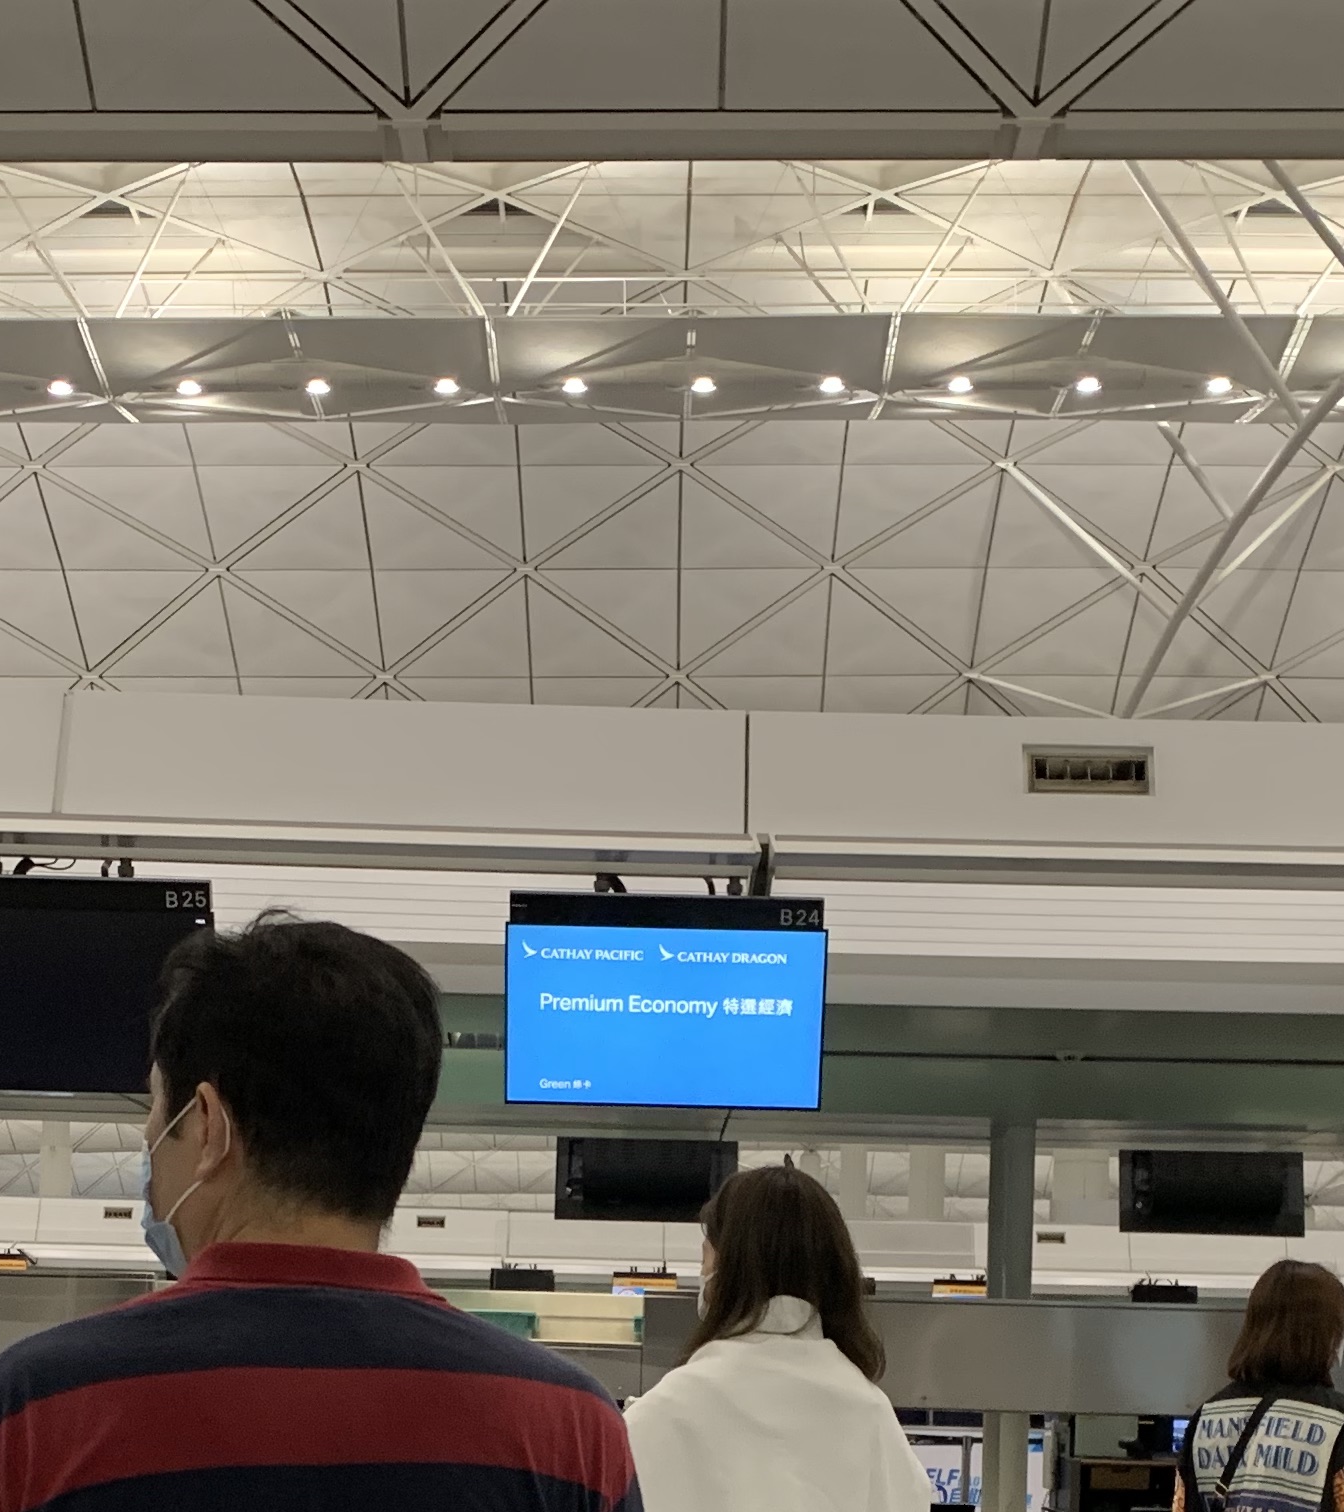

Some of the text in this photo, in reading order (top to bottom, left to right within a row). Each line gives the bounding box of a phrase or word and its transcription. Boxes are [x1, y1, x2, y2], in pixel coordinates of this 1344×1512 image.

[165, 889, 207, 909] B25
[779, 909, 820, 927] B24
[540, 947, 644, 962] CATHAY PACIFIC
[677, 951, 788, 966] CATHAY DRAGON
[539, 993, 794, 1018] Premium Economy 特選經濟
[538, 1077, 571, 1089] Green
[1254, 1443, 1320, 1477] MILD
